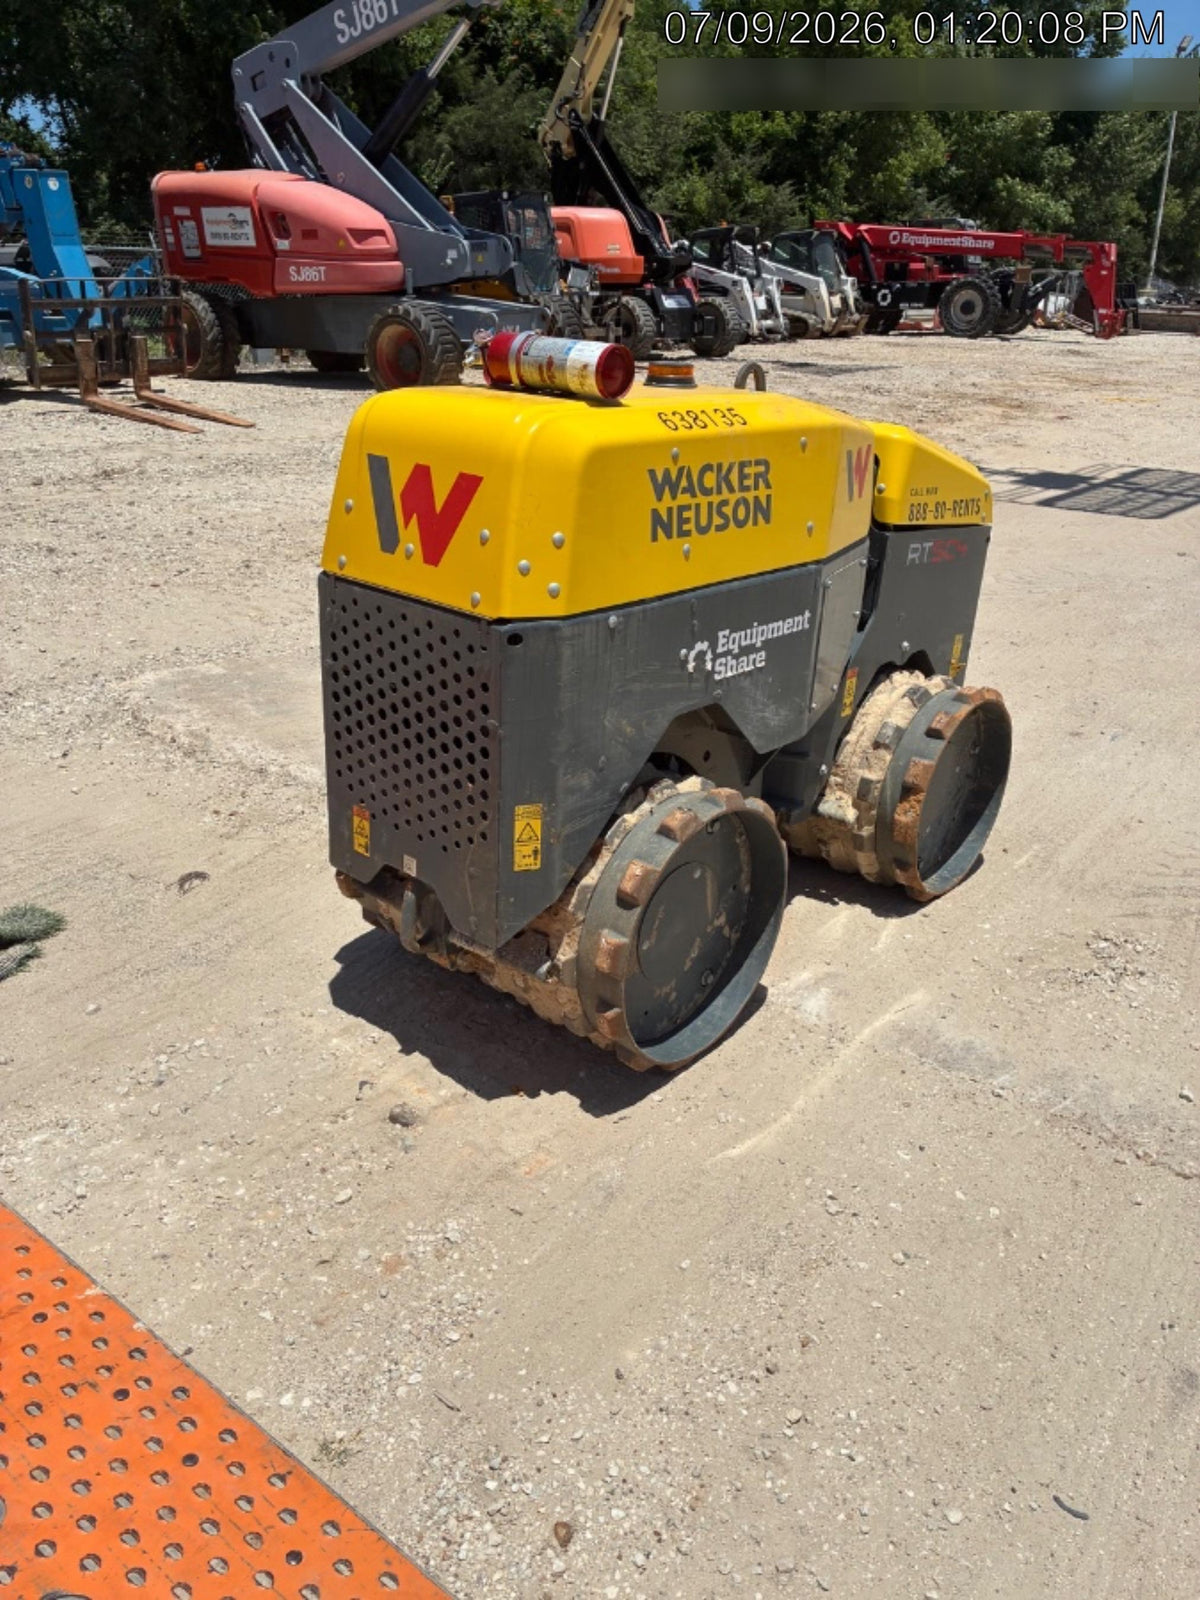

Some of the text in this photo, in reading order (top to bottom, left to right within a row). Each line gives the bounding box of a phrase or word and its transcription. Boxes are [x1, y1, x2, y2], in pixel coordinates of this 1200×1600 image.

[901, 232, 995, 249] EquipmentShare
[289, 265, 327, 282] SJ86T
[657, 407, 748, 431] 638135
[647, 458, 773, 503] WACKER
[650, 494, 773, 543] NEUSON
[716, 608, 812, 654] Equipment
[714, 650, 766, 681] Share
